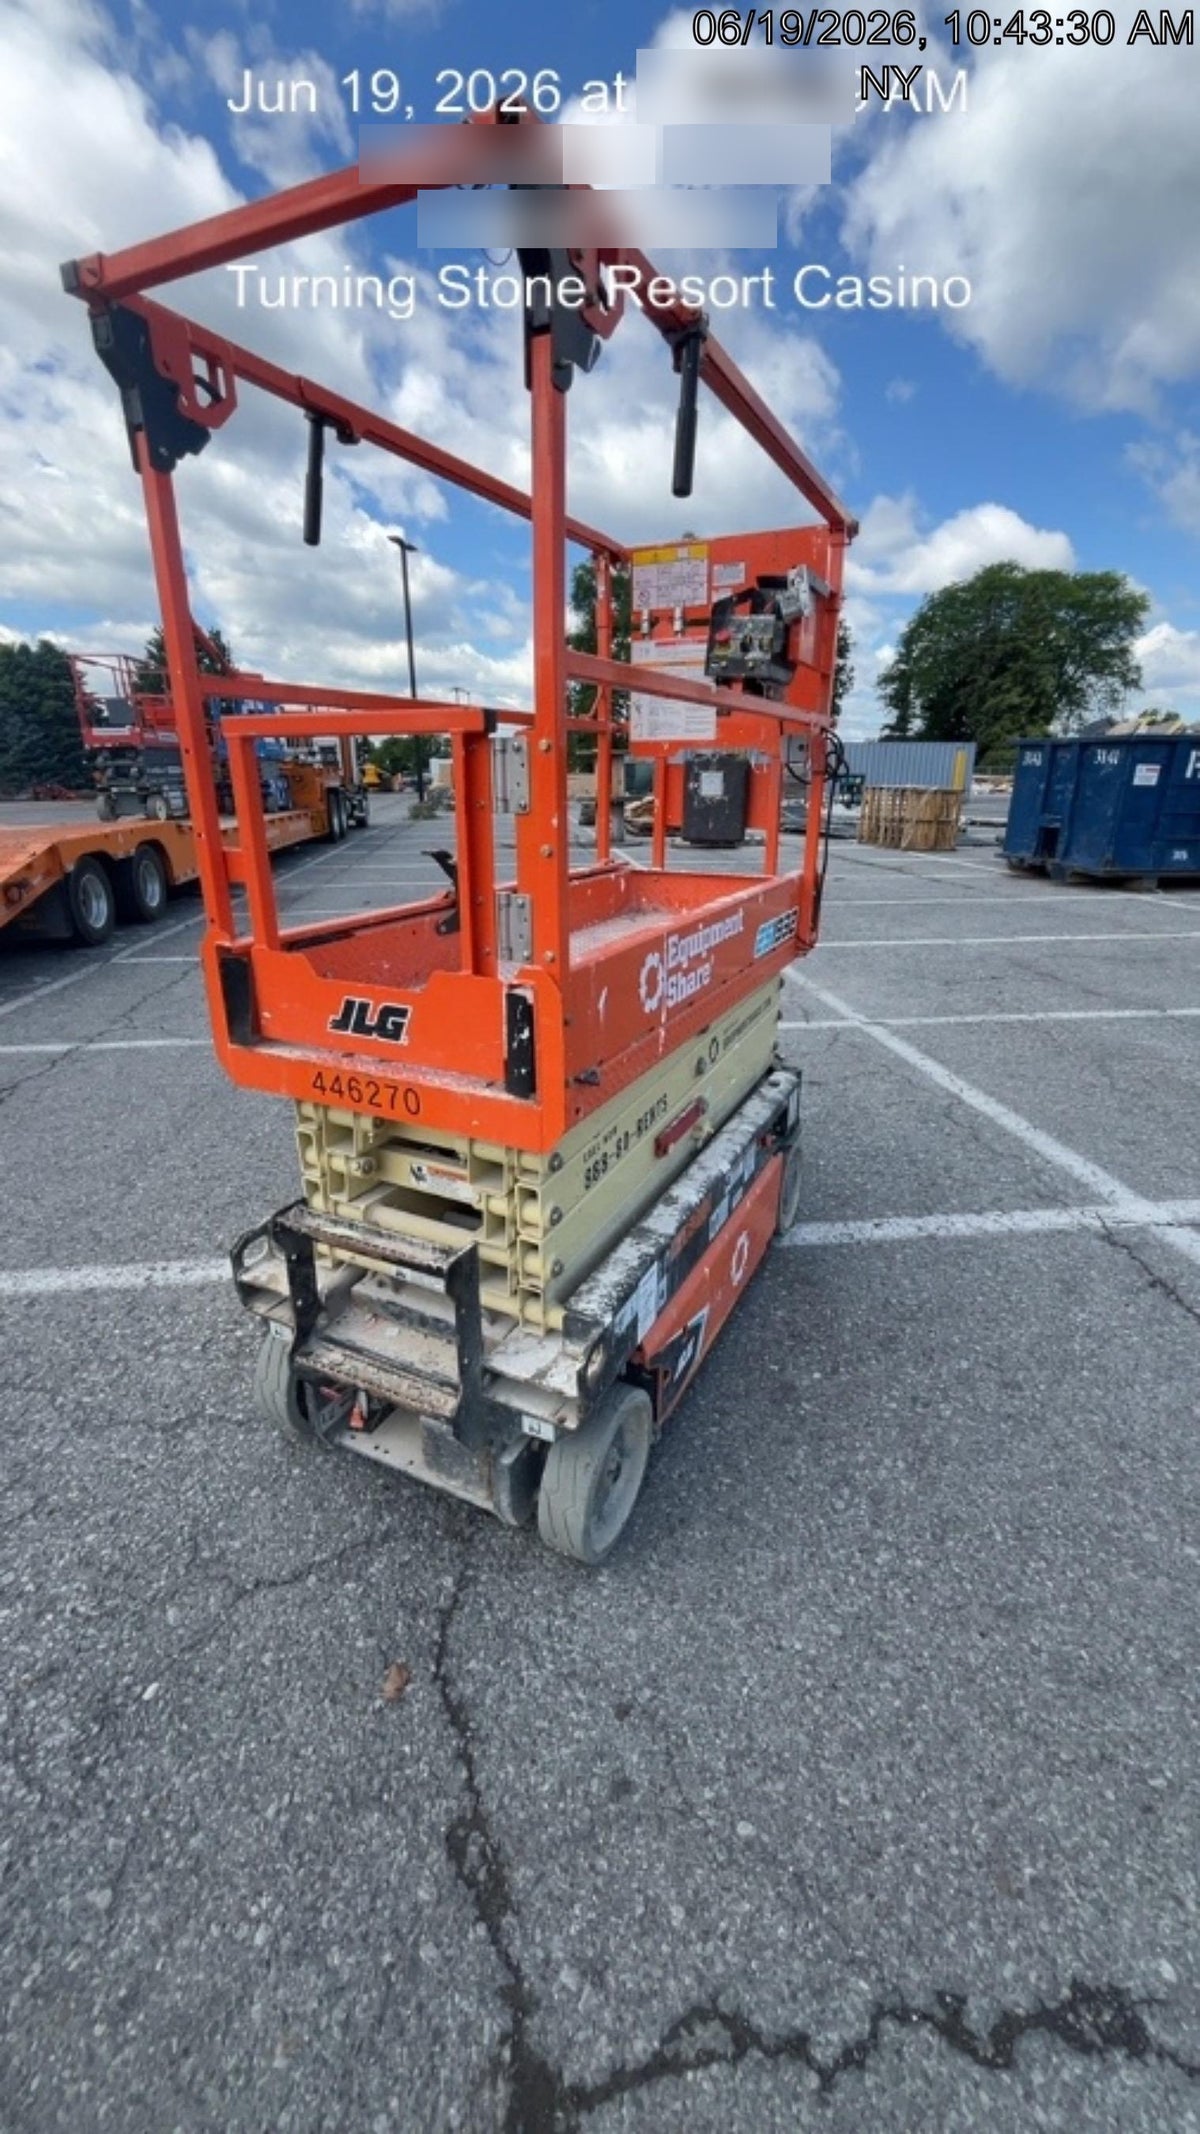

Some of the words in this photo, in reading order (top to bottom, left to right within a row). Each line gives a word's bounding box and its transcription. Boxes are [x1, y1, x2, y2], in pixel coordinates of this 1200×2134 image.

[668, 908, 744, 969] Equipment
[667, 961, 713, 1008] Share
[327, 997, 412, 1044] JLG
[312, 1071, 421, 1116] 446270
